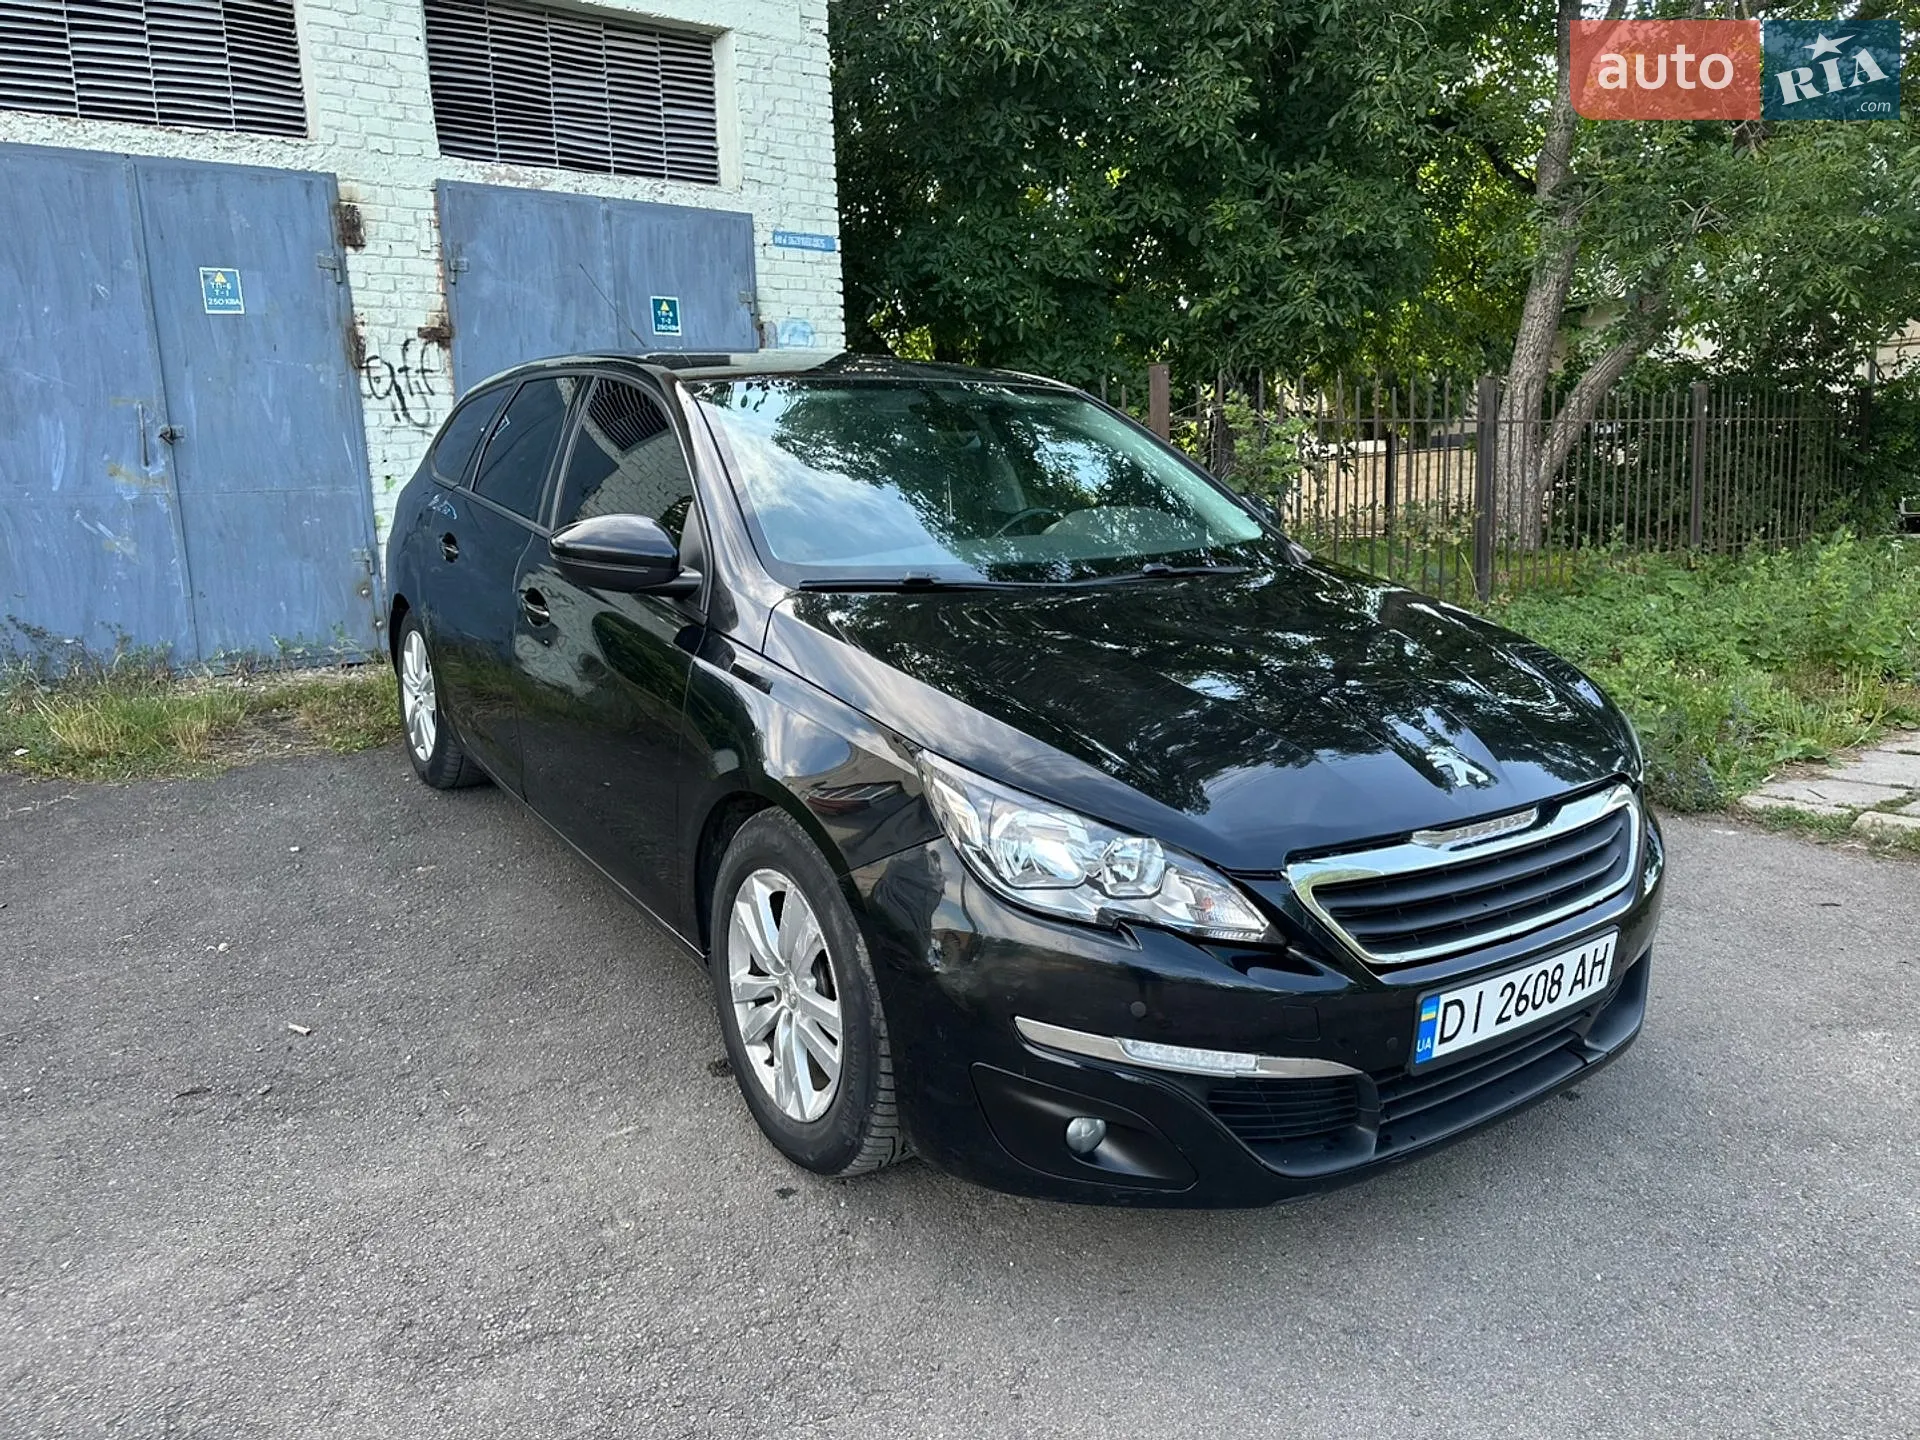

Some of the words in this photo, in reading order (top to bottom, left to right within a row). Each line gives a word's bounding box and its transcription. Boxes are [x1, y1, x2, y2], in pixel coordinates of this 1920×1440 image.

[1438, 991, 1484, 1046] DI
[1495, 963, 1564, 1026] 2608
[1568, 943, 1610, 996] AH
[1416, 1037, 1432, 1053] UA
